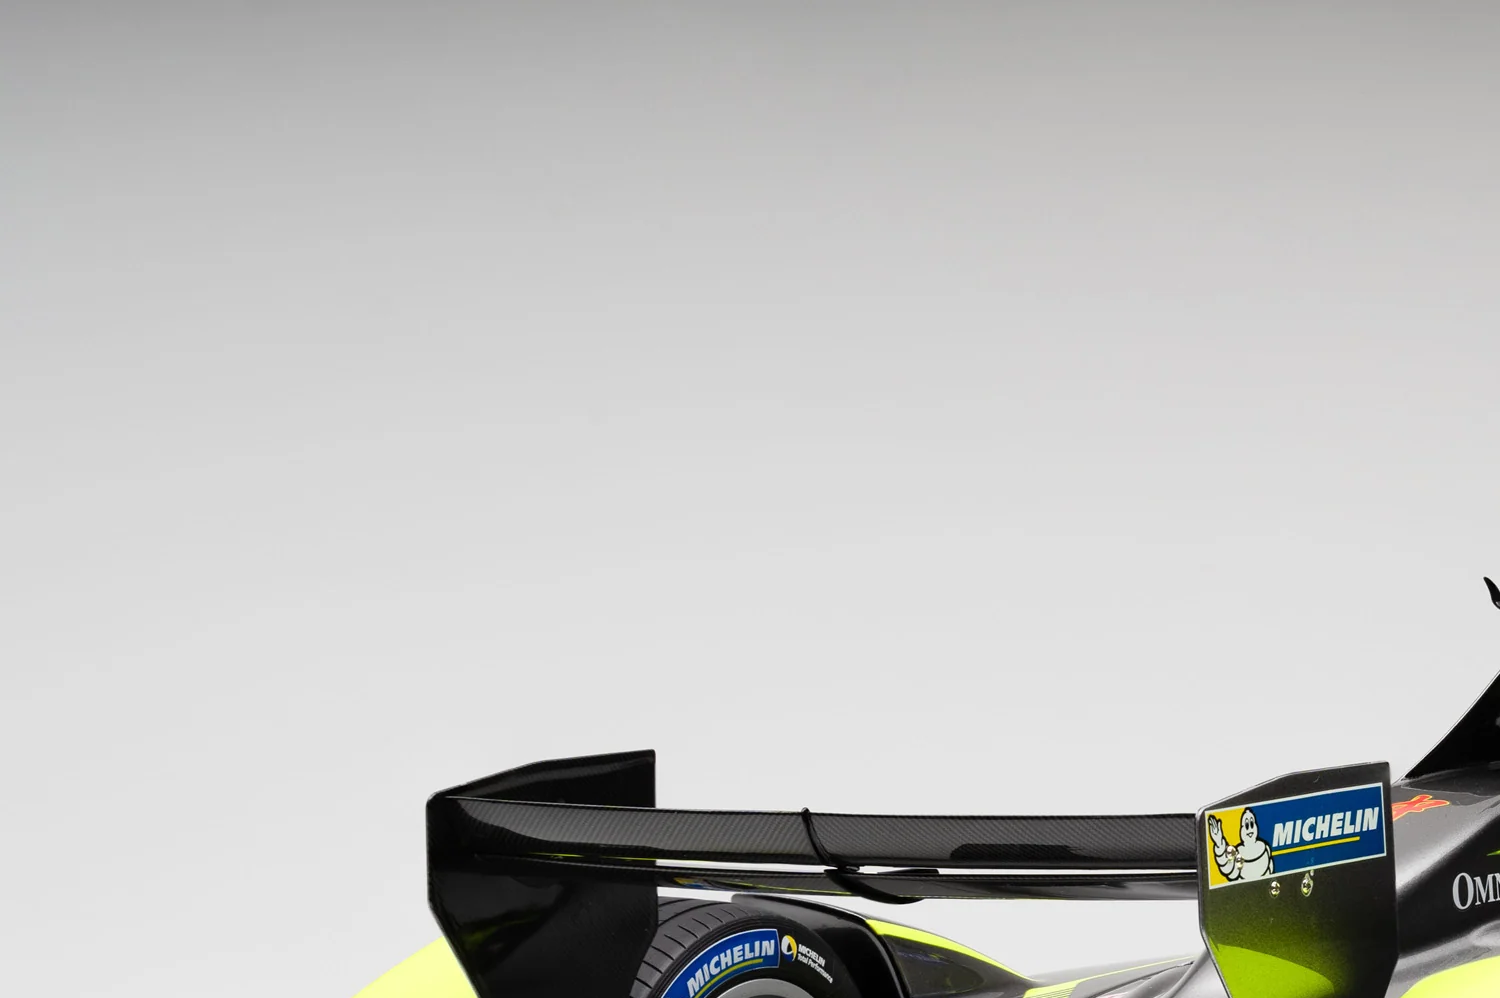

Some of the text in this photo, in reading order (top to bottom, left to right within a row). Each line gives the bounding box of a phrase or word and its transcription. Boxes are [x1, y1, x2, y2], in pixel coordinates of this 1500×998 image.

[1272, 807, 1380, 847] MICHELIN
[687, 939, 775, 998] MICHELIN
[798, 944, 826, 967] MICHELIN
